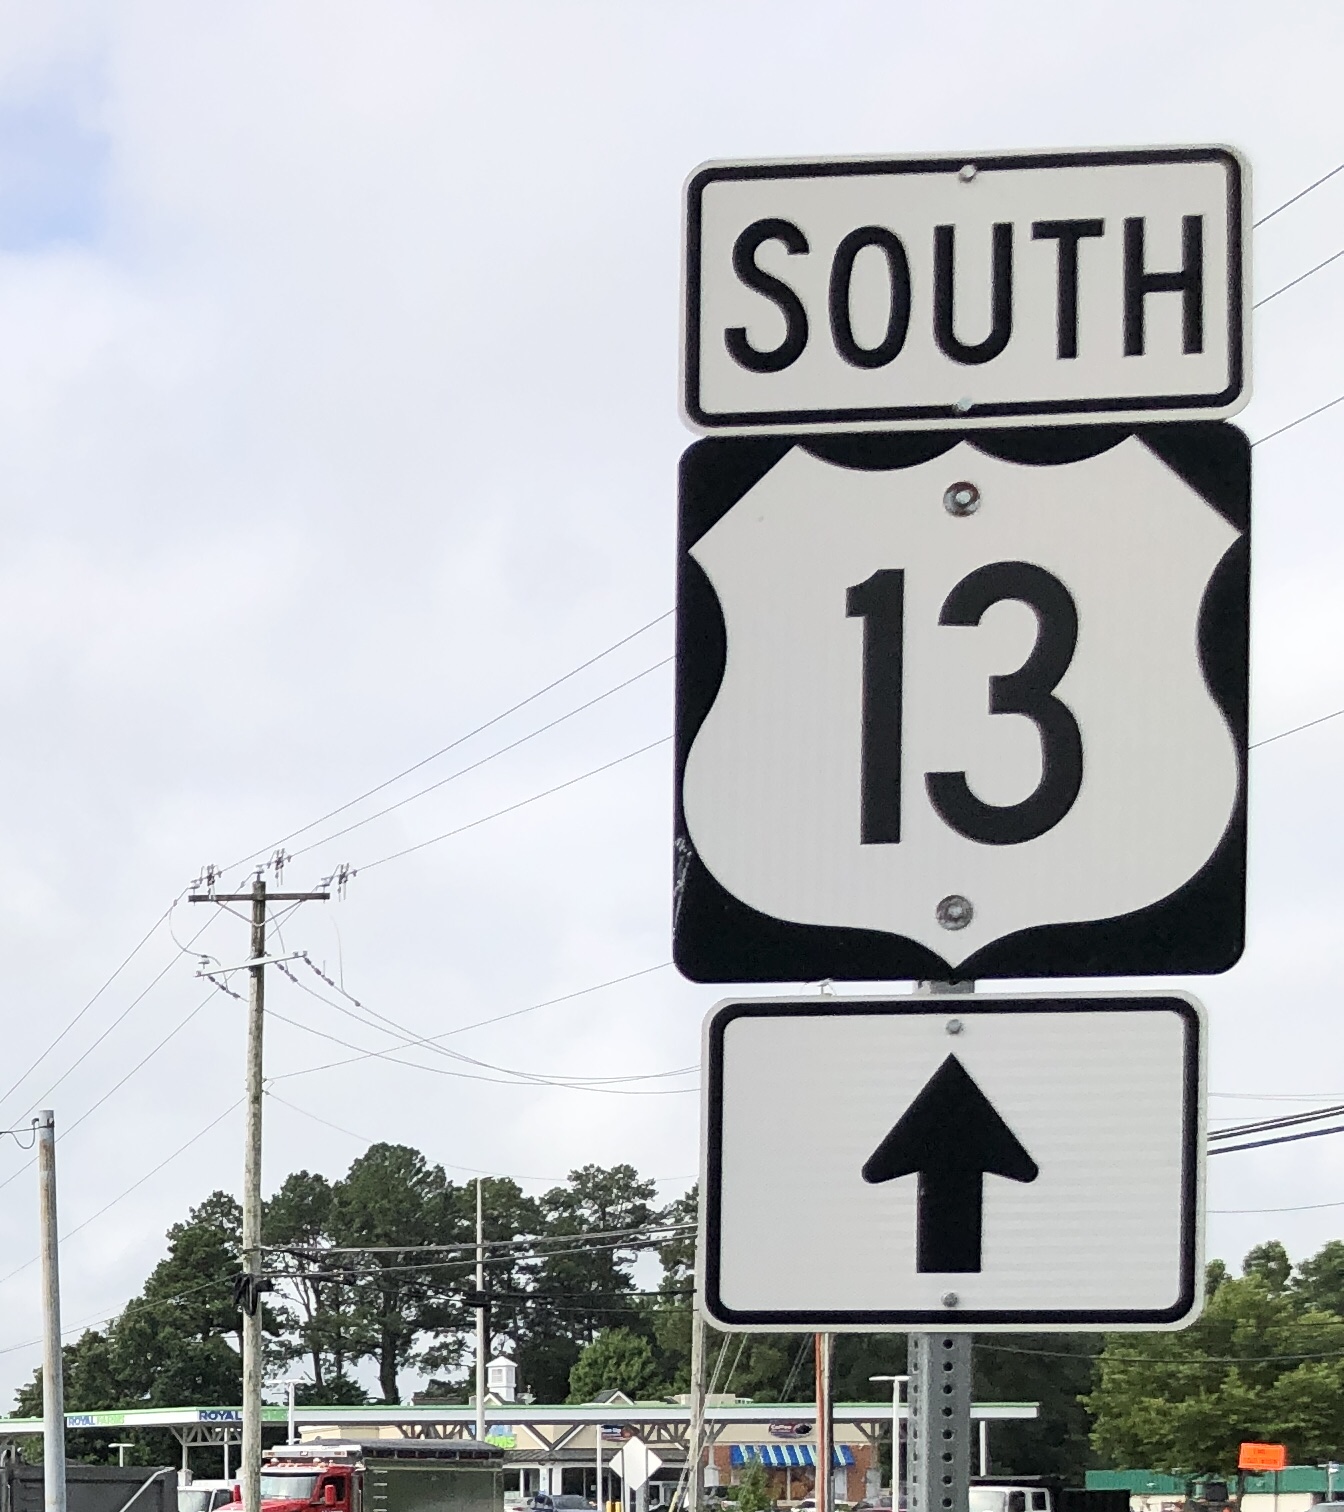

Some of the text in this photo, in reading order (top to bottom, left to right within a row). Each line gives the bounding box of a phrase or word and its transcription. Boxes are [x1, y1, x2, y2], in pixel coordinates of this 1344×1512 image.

[723, 214, 1206, 374] SOUTH
[844, 560, 1085, 846] 13
[68, 1415, 96, 1426] ROYAL
[198, 1409, 243, 1420] ROYAL
